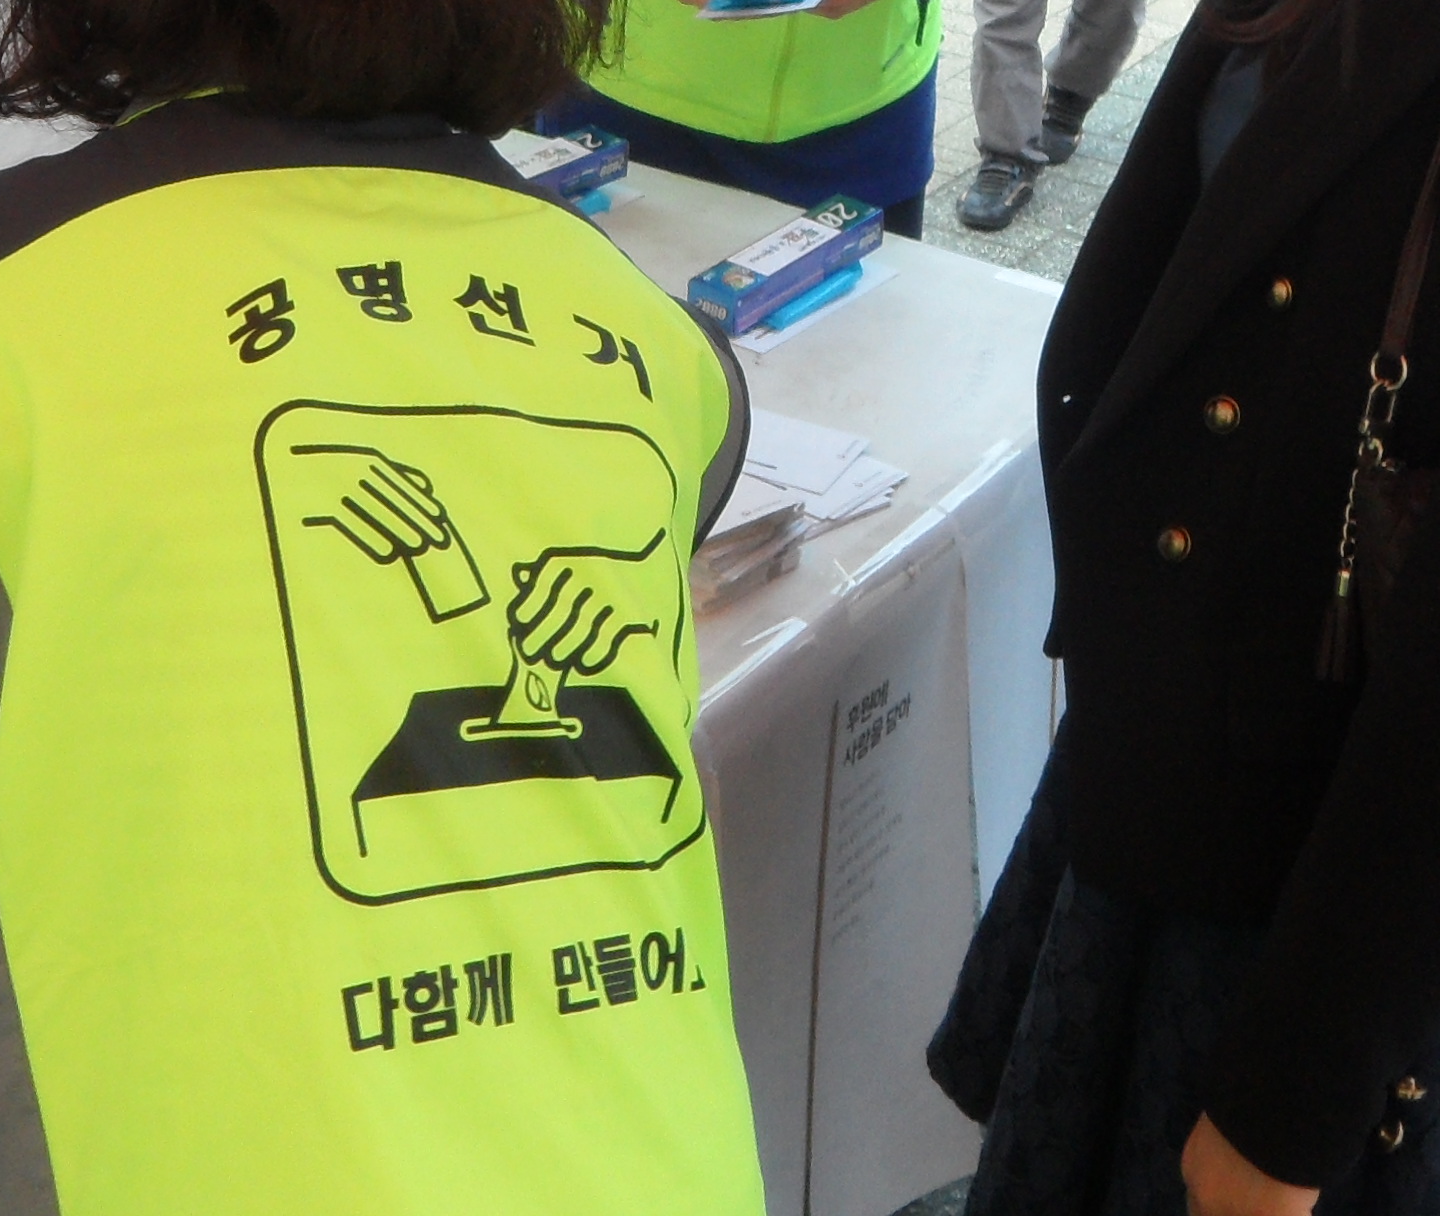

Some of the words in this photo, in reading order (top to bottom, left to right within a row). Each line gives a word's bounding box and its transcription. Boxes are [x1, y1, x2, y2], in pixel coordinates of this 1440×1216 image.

[843, 716, 883, 767] 사랑을
[885, 691, 912, 736] 담아
[847, 678, 890, 733] 후원에
[341, 952, 515, 1052] 다함께
[552, 926, 707, 1016] 만들어
